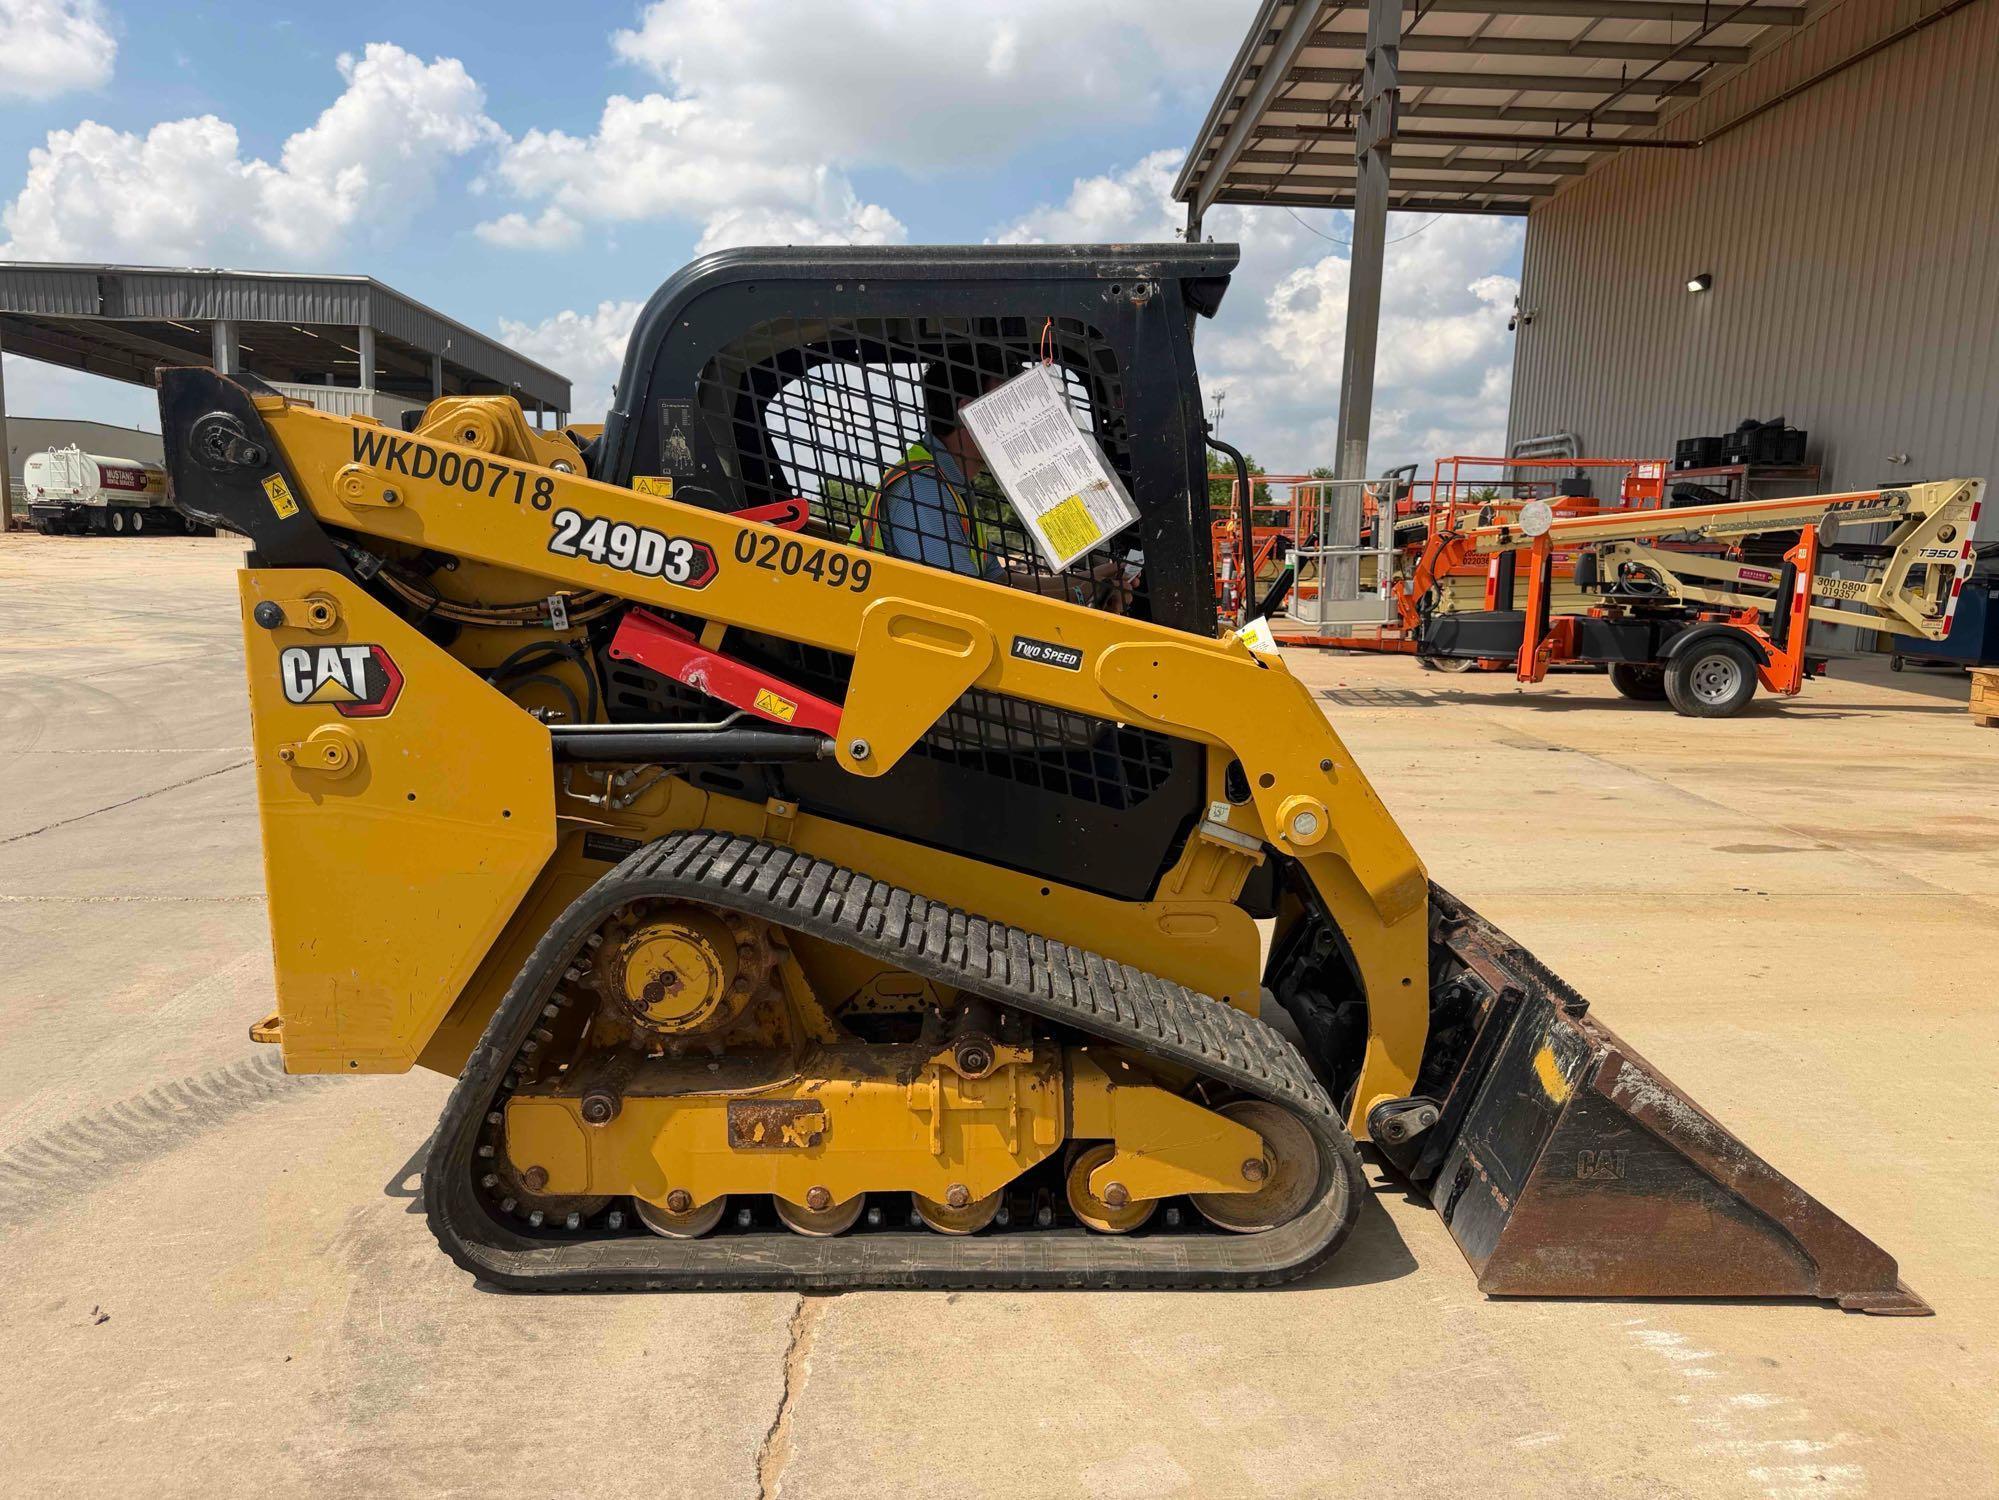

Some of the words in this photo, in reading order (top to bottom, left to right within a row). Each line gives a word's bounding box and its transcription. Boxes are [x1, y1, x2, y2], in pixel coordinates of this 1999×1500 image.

[106, 469, 135, 482] MUSTANG
[353, 427, 555, 511] WKD00718
[1824, 501, 1854, 512] JLG
[550, 509, 694, 583] 249D3
[1918, 548, 1959, 559] T350
[734, 528, 873, 593] 020499
[1817, 577, 1867, 593] 30016800
[1822, 588, 1857, 600] 019357
[1016, 641, 1041, 657] TWO
[1042, 648, 1078, 665] SPEED
[281, 646, 371, 702] CAT
[1577, 1149, 1630, 1180] CAT
